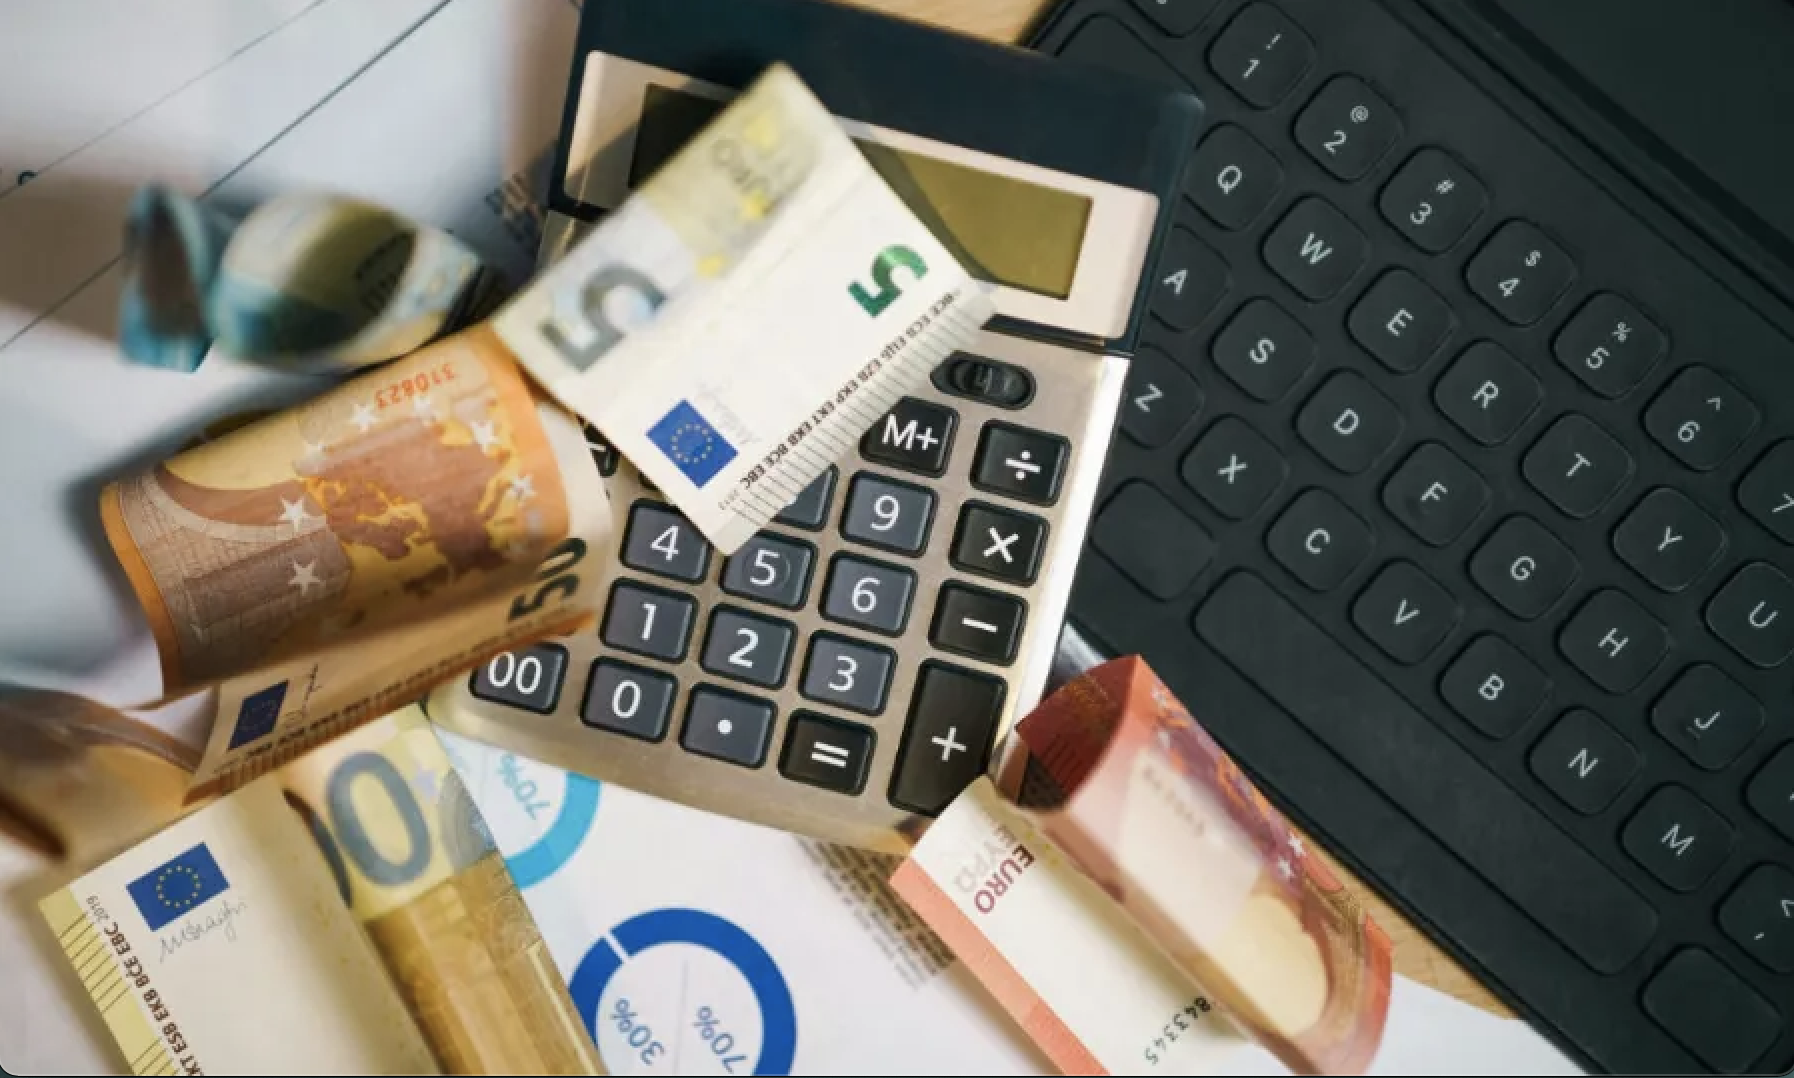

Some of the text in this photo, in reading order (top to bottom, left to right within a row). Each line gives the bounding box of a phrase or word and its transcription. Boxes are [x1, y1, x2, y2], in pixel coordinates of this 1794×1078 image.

[1265, 32, 1282, 52] !
[1242, 57, 1260, 80] 1
[1349, 105, 1369, 123] @
[1323, 129, 1347, 153] 2
[1217, 165, 1243, 195] Q
[1409, 201, 1433, 225] 3
[1299, 231, 1333, 265] W
[847, 245, 929, 318] 5
[1163, 269, 1189, 295] A
[1499, 277, 1521, 297] 4
[538, 262, 668, 374] 5
[1385, 307, 1413, 337] E
[1249, 337, 1275, 365] S
[1585, 347, 1609, 369] 5
[1134, 383, 1163, 413] Z
[1471, 379, 1499, 409] R
[787, 421, 813, 446] EKB
[881, 412, 940, 452] M+
[1333, 407, 1359, 435] D
[1677, 421, 1701, 443] 6
[740, 463, 766, 490] EBC
[1217, 453, 1247, 485] X
[1565, 453, 1591, 477] T
[1421, 481, 1449, 507] F
[871, 495, 901, 532] 9
[651, 525, 679, 561] 4
[1305, 527, 1331, 555] C
[1657, 525, 1683, 551] Y
[508, 537, 588, 622] 50
[749, 549, 779, 587] 5
[1509, 555, 1537, 581] G
[851, 577, 881, 614] 6
[641, 603, 657, 641] 1
[1395, 599, 1419, 625] V
[1749, 601, 1777, 629] U
[729, 629, 759, 669] 2
[1597, 627, 1629, 657] H
[486, 650, 543, 695] 00
[827, 655, 857, 693] 3
[1477, 673, 1505, 701] B
[611, 679, 641, 719] 0
[1693, 709, 1721, 731] J
[1567, 747, 1599, 779] N
[496, 752, 551, 821] 70%
[1661, 823, 1695, 855] M
[973, 842, 1036, 915] EURO
[103, 921, 131, 955] EBC
[143, 988, 171, 1022] EKB
[162, 1021, 188, 1054] ESB
[609, 997, 666, 1067] 30%
[691, 1005, 748, 1075] 70%
